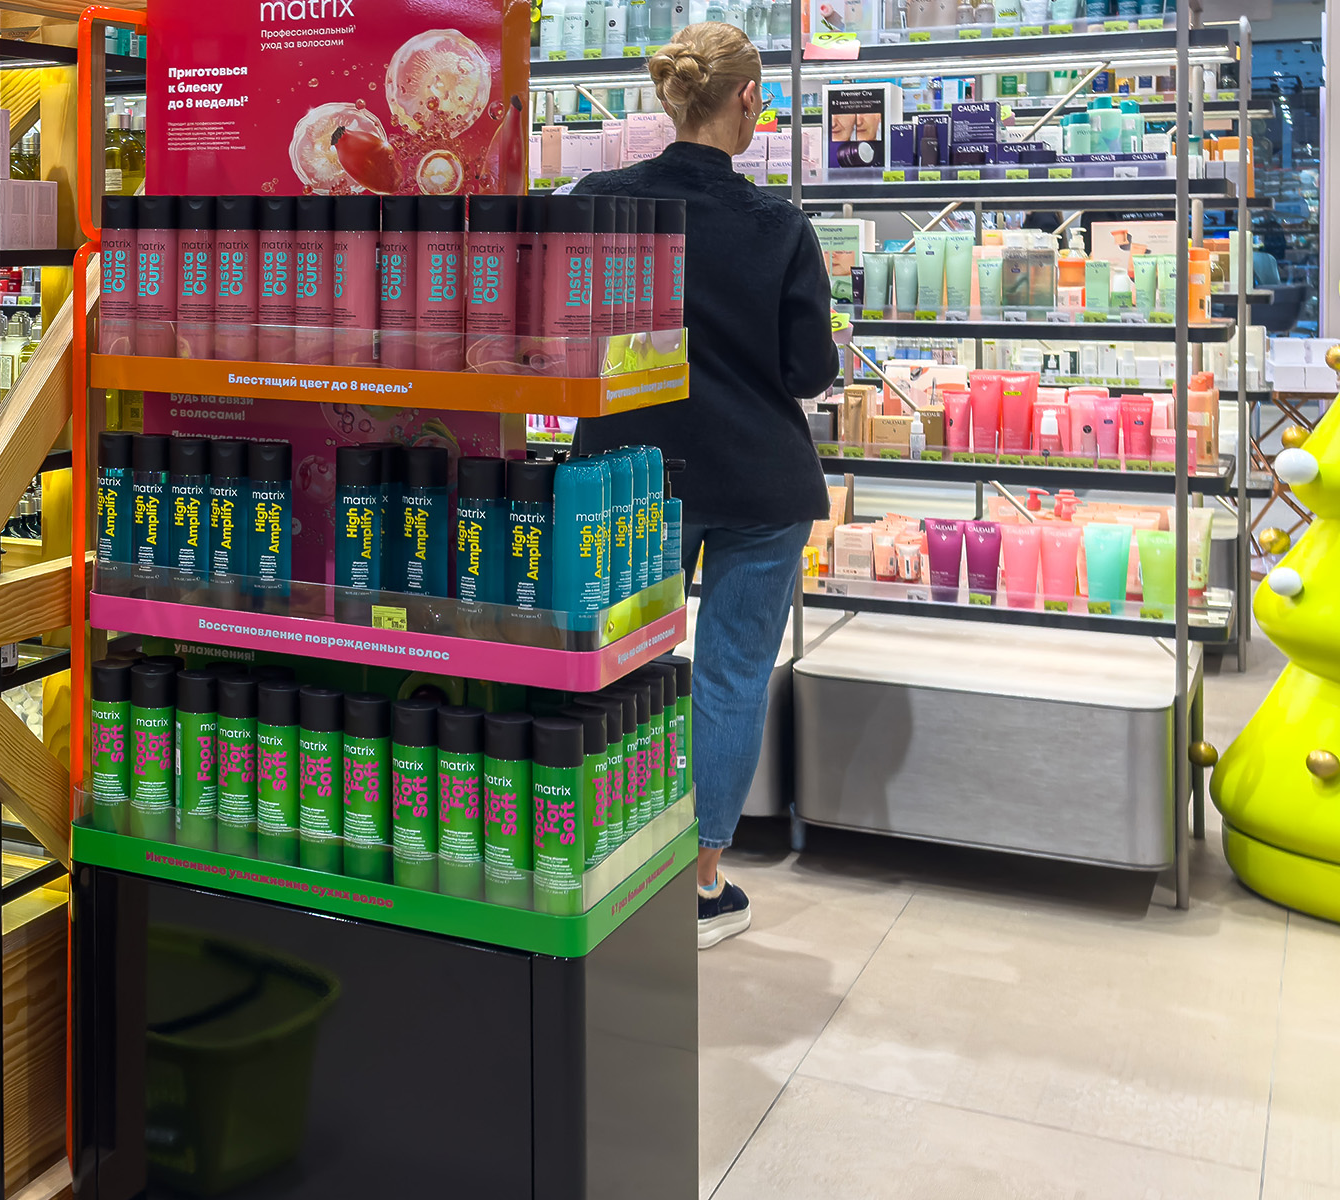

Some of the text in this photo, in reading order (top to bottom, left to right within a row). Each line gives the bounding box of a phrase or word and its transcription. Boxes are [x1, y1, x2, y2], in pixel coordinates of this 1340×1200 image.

[260, 0, 355, 21] matrix
[261, 42, 282, 51] уход
[297, 39, 344, 48] волосами
[168, 66, 248, 80] Приготовься
[168, 82, 223, 94] к блеску
[168, 99, 184, 110] до
[186, 97, 193, 108] 8
[957, 104, 990, 112] CAUDALIE
[957, 145, 989, 153] CAUDALIE
[102, 240, 132, 248] matrix
[182, 241, 212, 250] matrix
[262, 241, 293, 249] matrix
[471, 244, 505, 254] matrix
[102, 250, 112, 293] Insta
[112, 250, 126, 292] Cure
[138, 253, 146, 296] Insta
[146, 253, 160, 295] Cure
[182, 252, 193, 296] Insta
[194, 252, 207, 295] Cure
[219, 252, 229, 296] Insta
[229, 252, 243, 295] Cure
[262, 252, 273, 296] Insta
[273, 252, 287, 295] Cure
[471, 256, 484, 304] Insta
[483, 255, 499, 303] Cure
[228, 373, 297, 388] Блестящий
[300, 378, 329, 389] цвет
[332, 381, 348, 391] до
[350, 381, 358, 390] 8
[170, 408, 245, 421] с волосами!
[201, 395, 216, 404] на
[218, 395, 254, 406] связи
[133, 484, 163, 493] matrix
[252, 491, 285, 500] matrix
[343, 496, 376, 505] matrix
[135, 495, 146, 524] High
[146, 496, 160, 545] Amplify
[255, 503, 268, 532] High
[346, 507, 361, 538] High
[510, 513, 545, 523] matrix
[269, 503, 282, 553] Amplify
[361, 508, 374, 559] Amplify
[513, 526, 526, 557] High
[930, 524, 958, 532] CAUDALIE
[968, 526, 996, 534] CAUDALIE
[526, 526, 542, 580] Amplify
[174, 642, 255, 662] увлажнения!
[198, 618, 450, 661] Восстановление поврежденных волос
[136, 718, 168, 727] matrix
[134, 730, 146, 776] Food
[146, 732, 160, 761] For
[160, 731, 171, 770] Soft
[440, 759, 475, 771] matrix
[439, 772, 450, 823] Food
[450, 776, 464, 808] For
[464, 776, 479, 819] Soft
[535, 783, 571, 796] matrix
[534, 796, 545, 848] Food
[545, 800, 560, 833] For
[560, 801, 575, 845] Soft
[146, 851, 393, 908] Интенсивное увлажнение сухих волос
